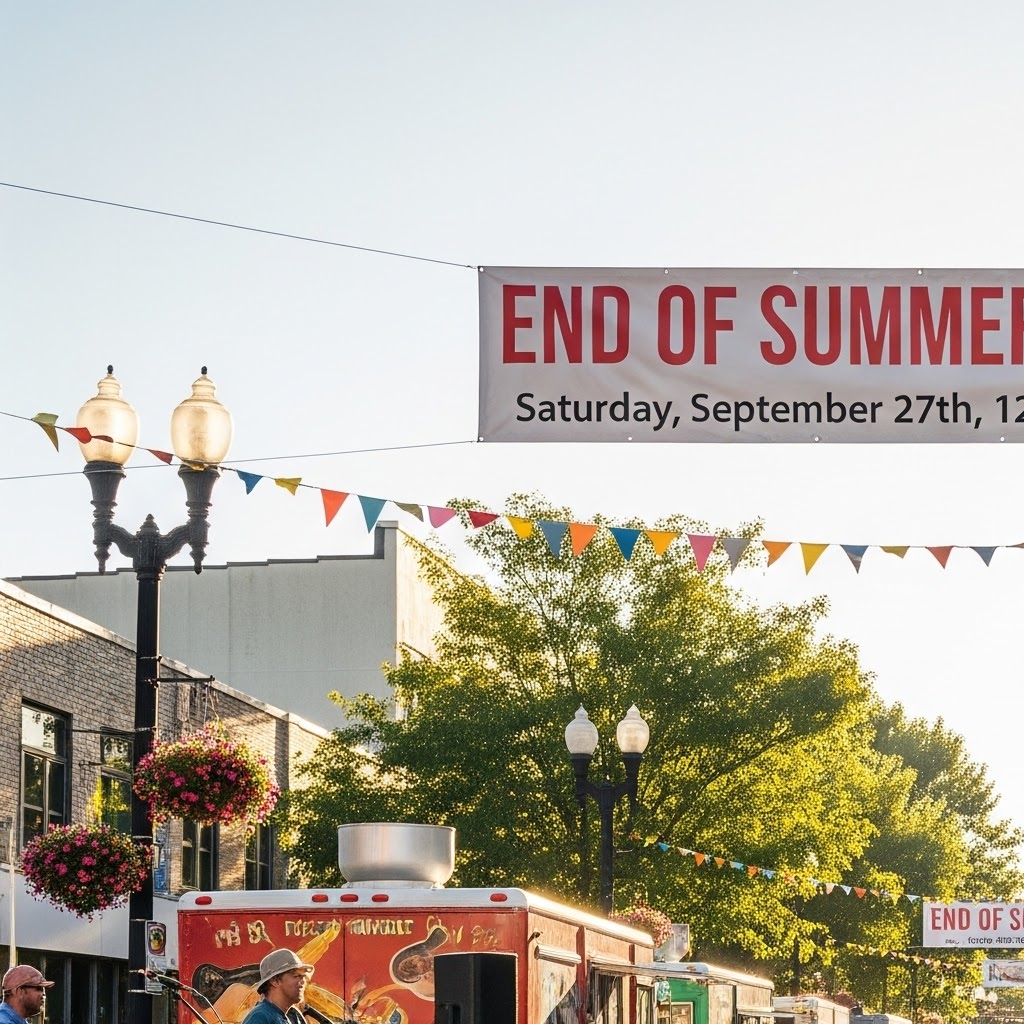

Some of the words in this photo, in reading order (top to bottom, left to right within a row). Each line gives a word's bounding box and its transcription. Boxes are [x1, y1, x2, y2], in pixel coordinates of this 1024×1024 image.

[502, 283, 631, 365] END
[657, 284, 738, 367] OF
[515, 391, 681, 432] Saturday,
[691, 392, 884, 432] September
[894, 391, 983, 430] 27th,
[930, 907, 971, 932] END
[978, 907, 1004, 932] OF
